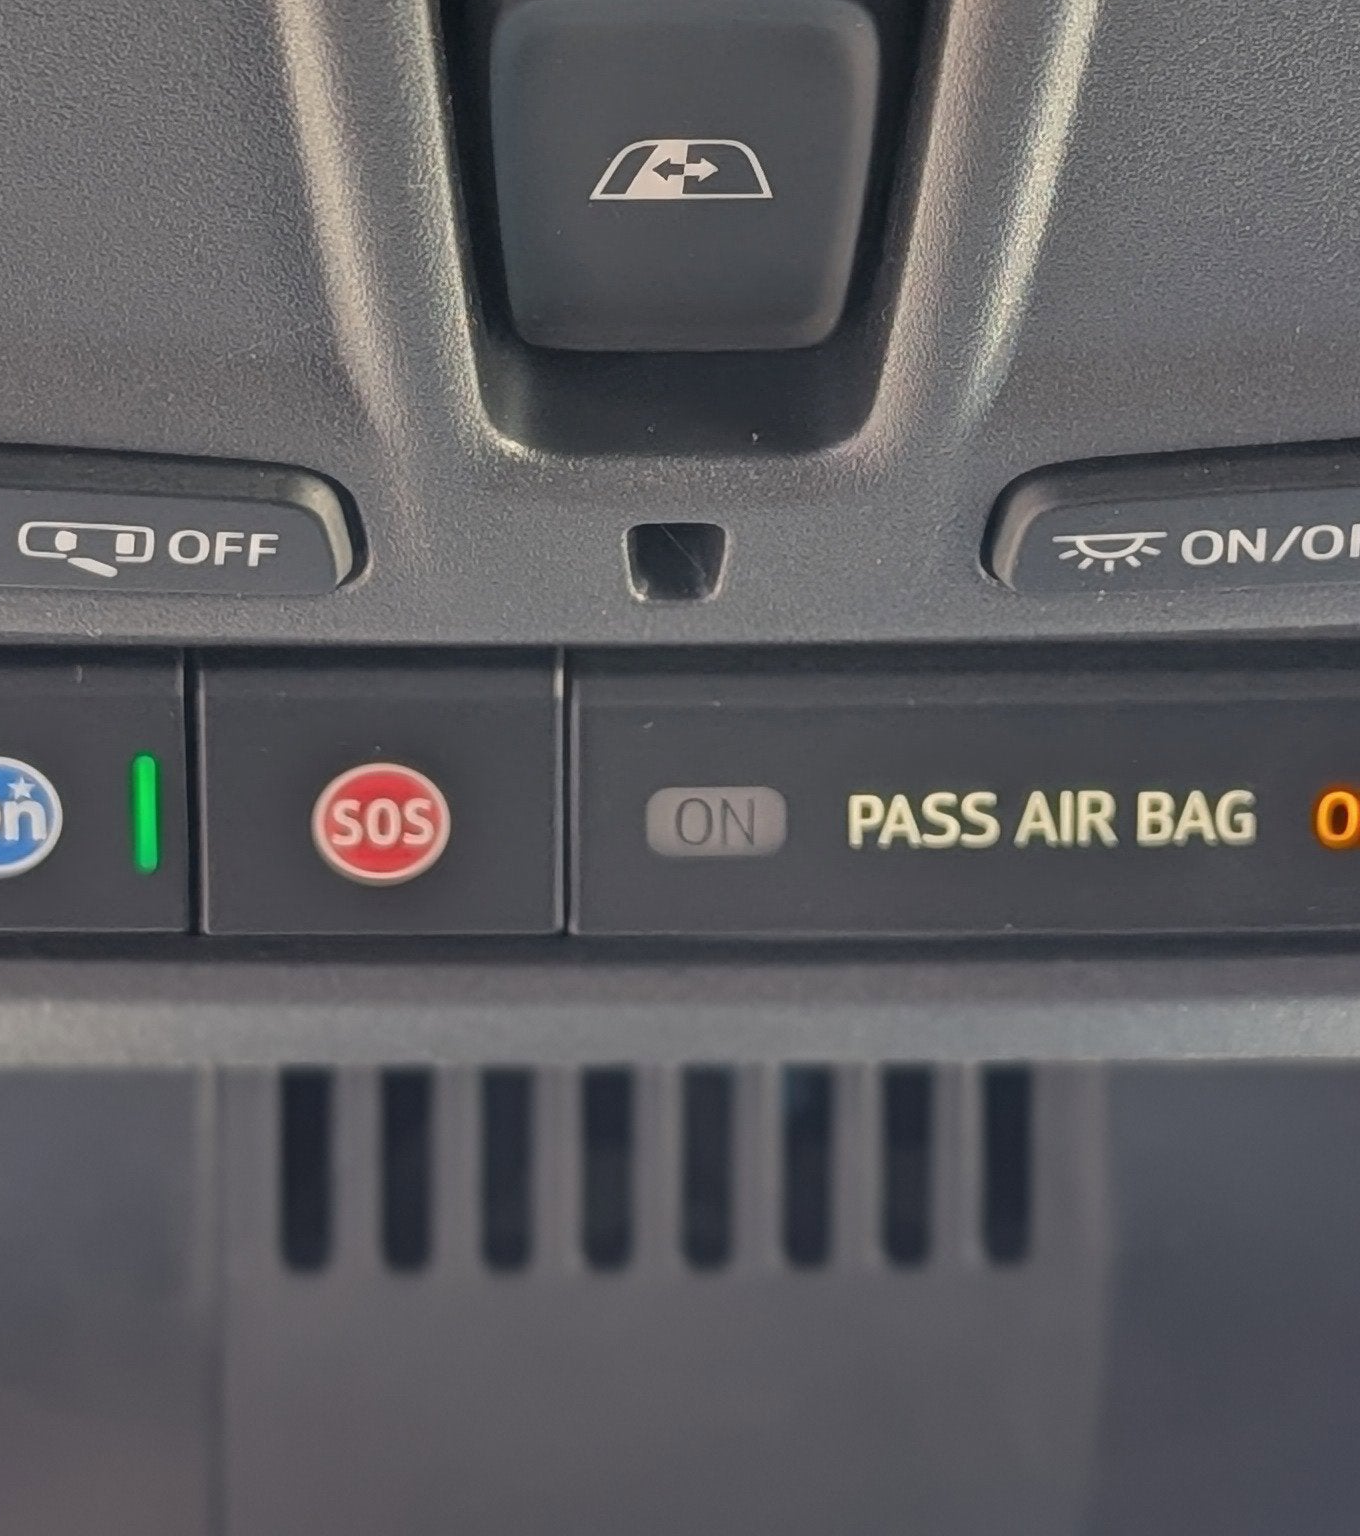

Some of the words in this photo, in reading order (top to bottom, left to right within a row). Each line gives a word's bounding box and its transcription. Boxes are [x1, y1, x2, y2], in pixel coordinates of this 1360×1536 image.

[167, 529, 281, 569] OFF
[332, 795, 435, 845] SOS
[673, 796, 759, 846] ON
[846, 793, 1001, 850] PASS
[1013, 792, 1120, 848] AIR
[1135, 790, 1259, 845] BAG
